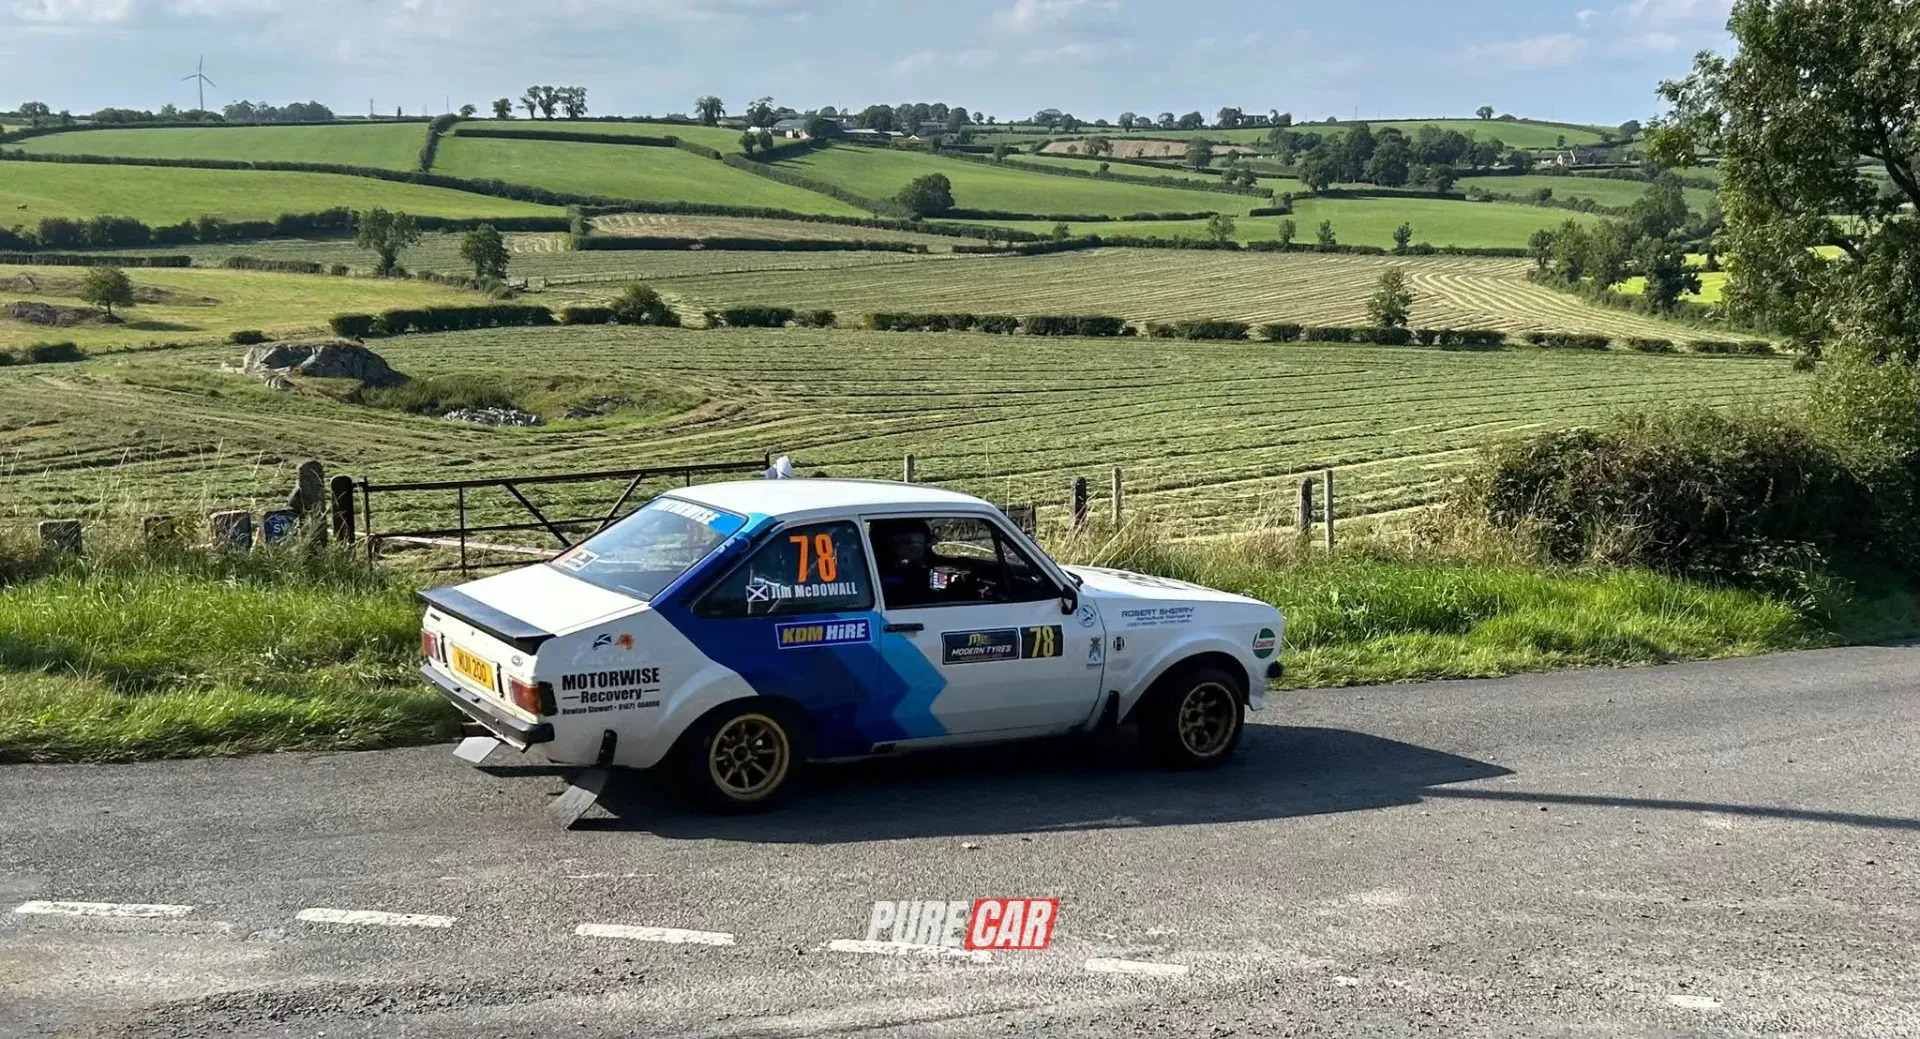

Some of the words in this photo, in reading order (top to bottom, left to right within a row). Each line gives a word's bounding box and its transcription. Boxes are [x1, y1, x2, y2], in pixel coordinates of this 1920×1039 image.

[789, 533, 837, 583] 78
[795, 582, 858, 598] McDOWALL
[1121, 608, 1157, 618] ROBERT
[1159, 605, 1195, 615] SHERRY
[782, 625, 824, 644] KDM
[825, 623, 866, 640] HiRE
[1029, 626, 1055, 658] 78
[951, 646, 985, 656] MODERN
[986, 644, 1012, 654] TYRES
[562, 667, 660, 691] MOTORWISE
[581, 688, 642, 703] Recovery
